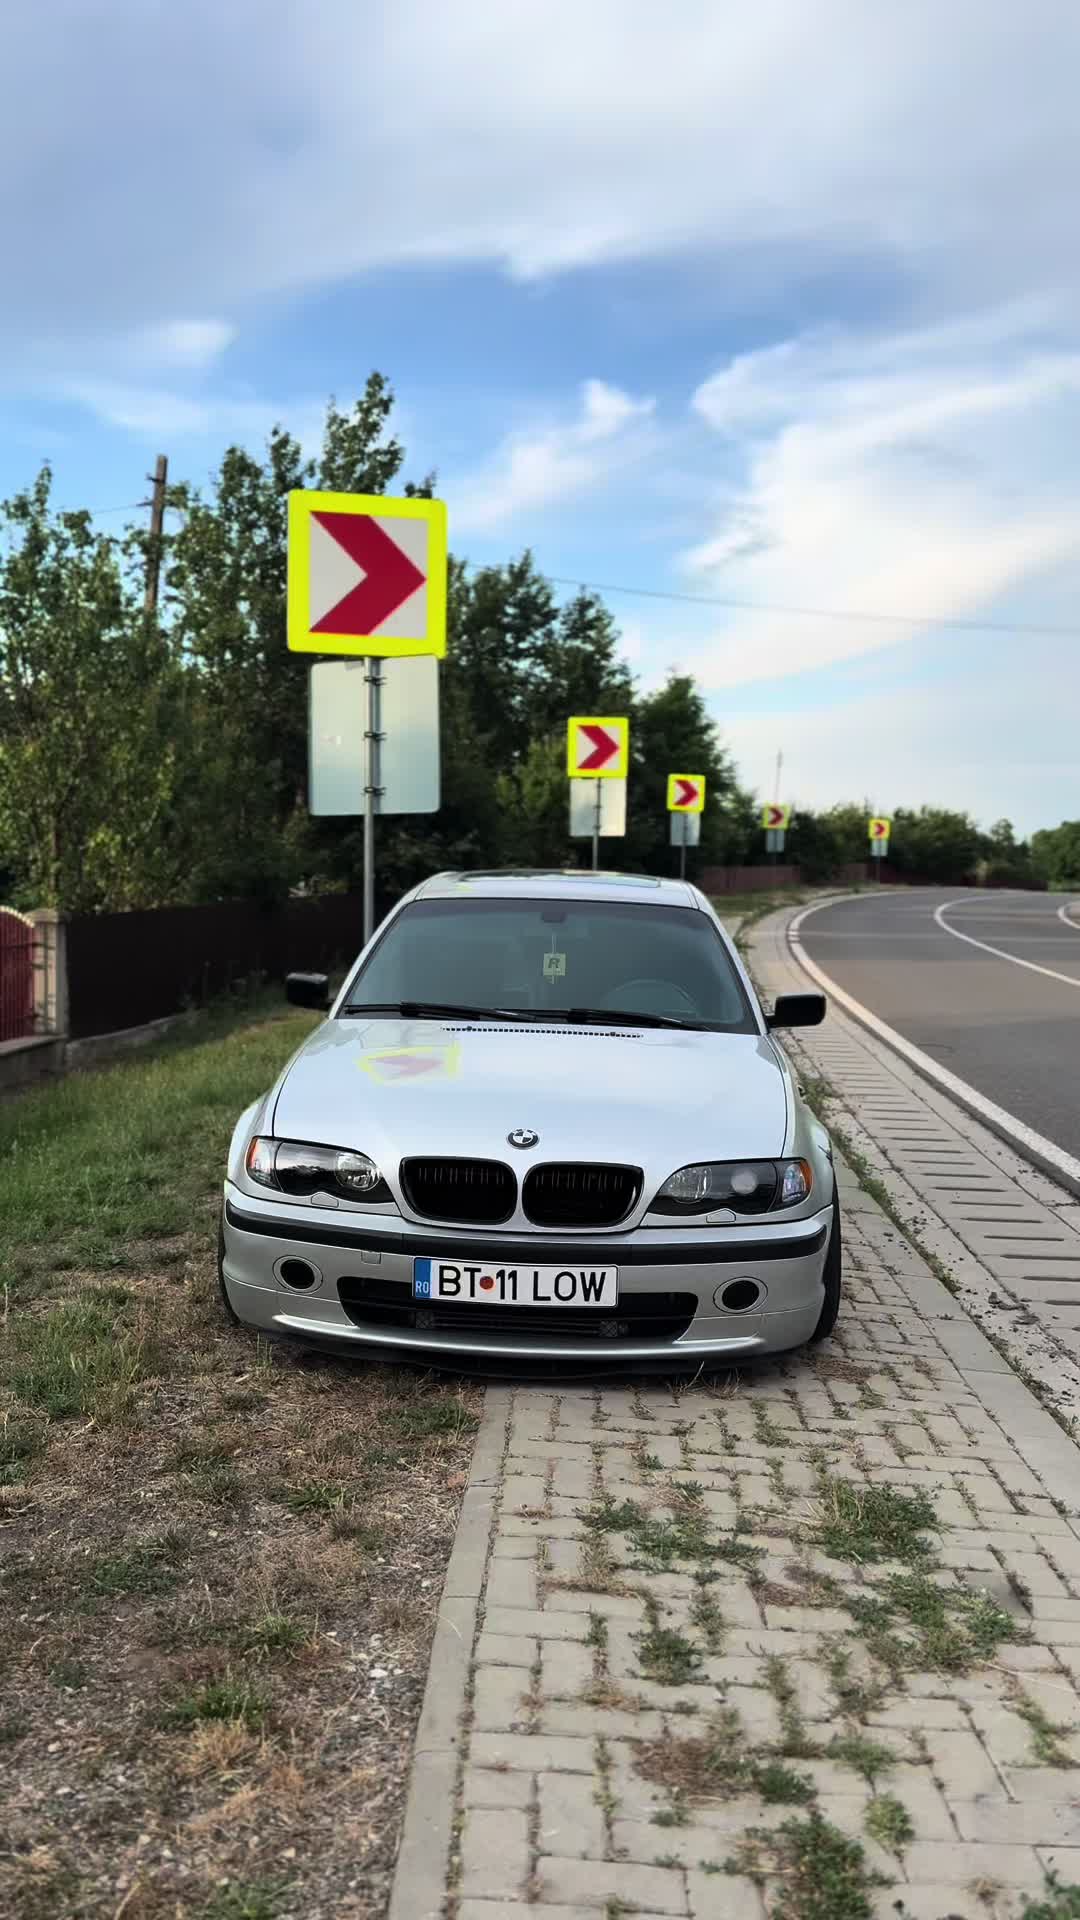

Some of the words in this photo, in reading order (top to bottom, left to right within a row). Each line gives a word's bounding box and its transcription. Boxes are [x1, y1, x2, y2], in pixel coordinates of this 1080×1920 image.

[415, 1280, 429, 1294] RO
[438, 1265, 482, 1298] BT
[495, 1269, 518, 1301] 11
[533, 1270, 607, 1303] LOW
